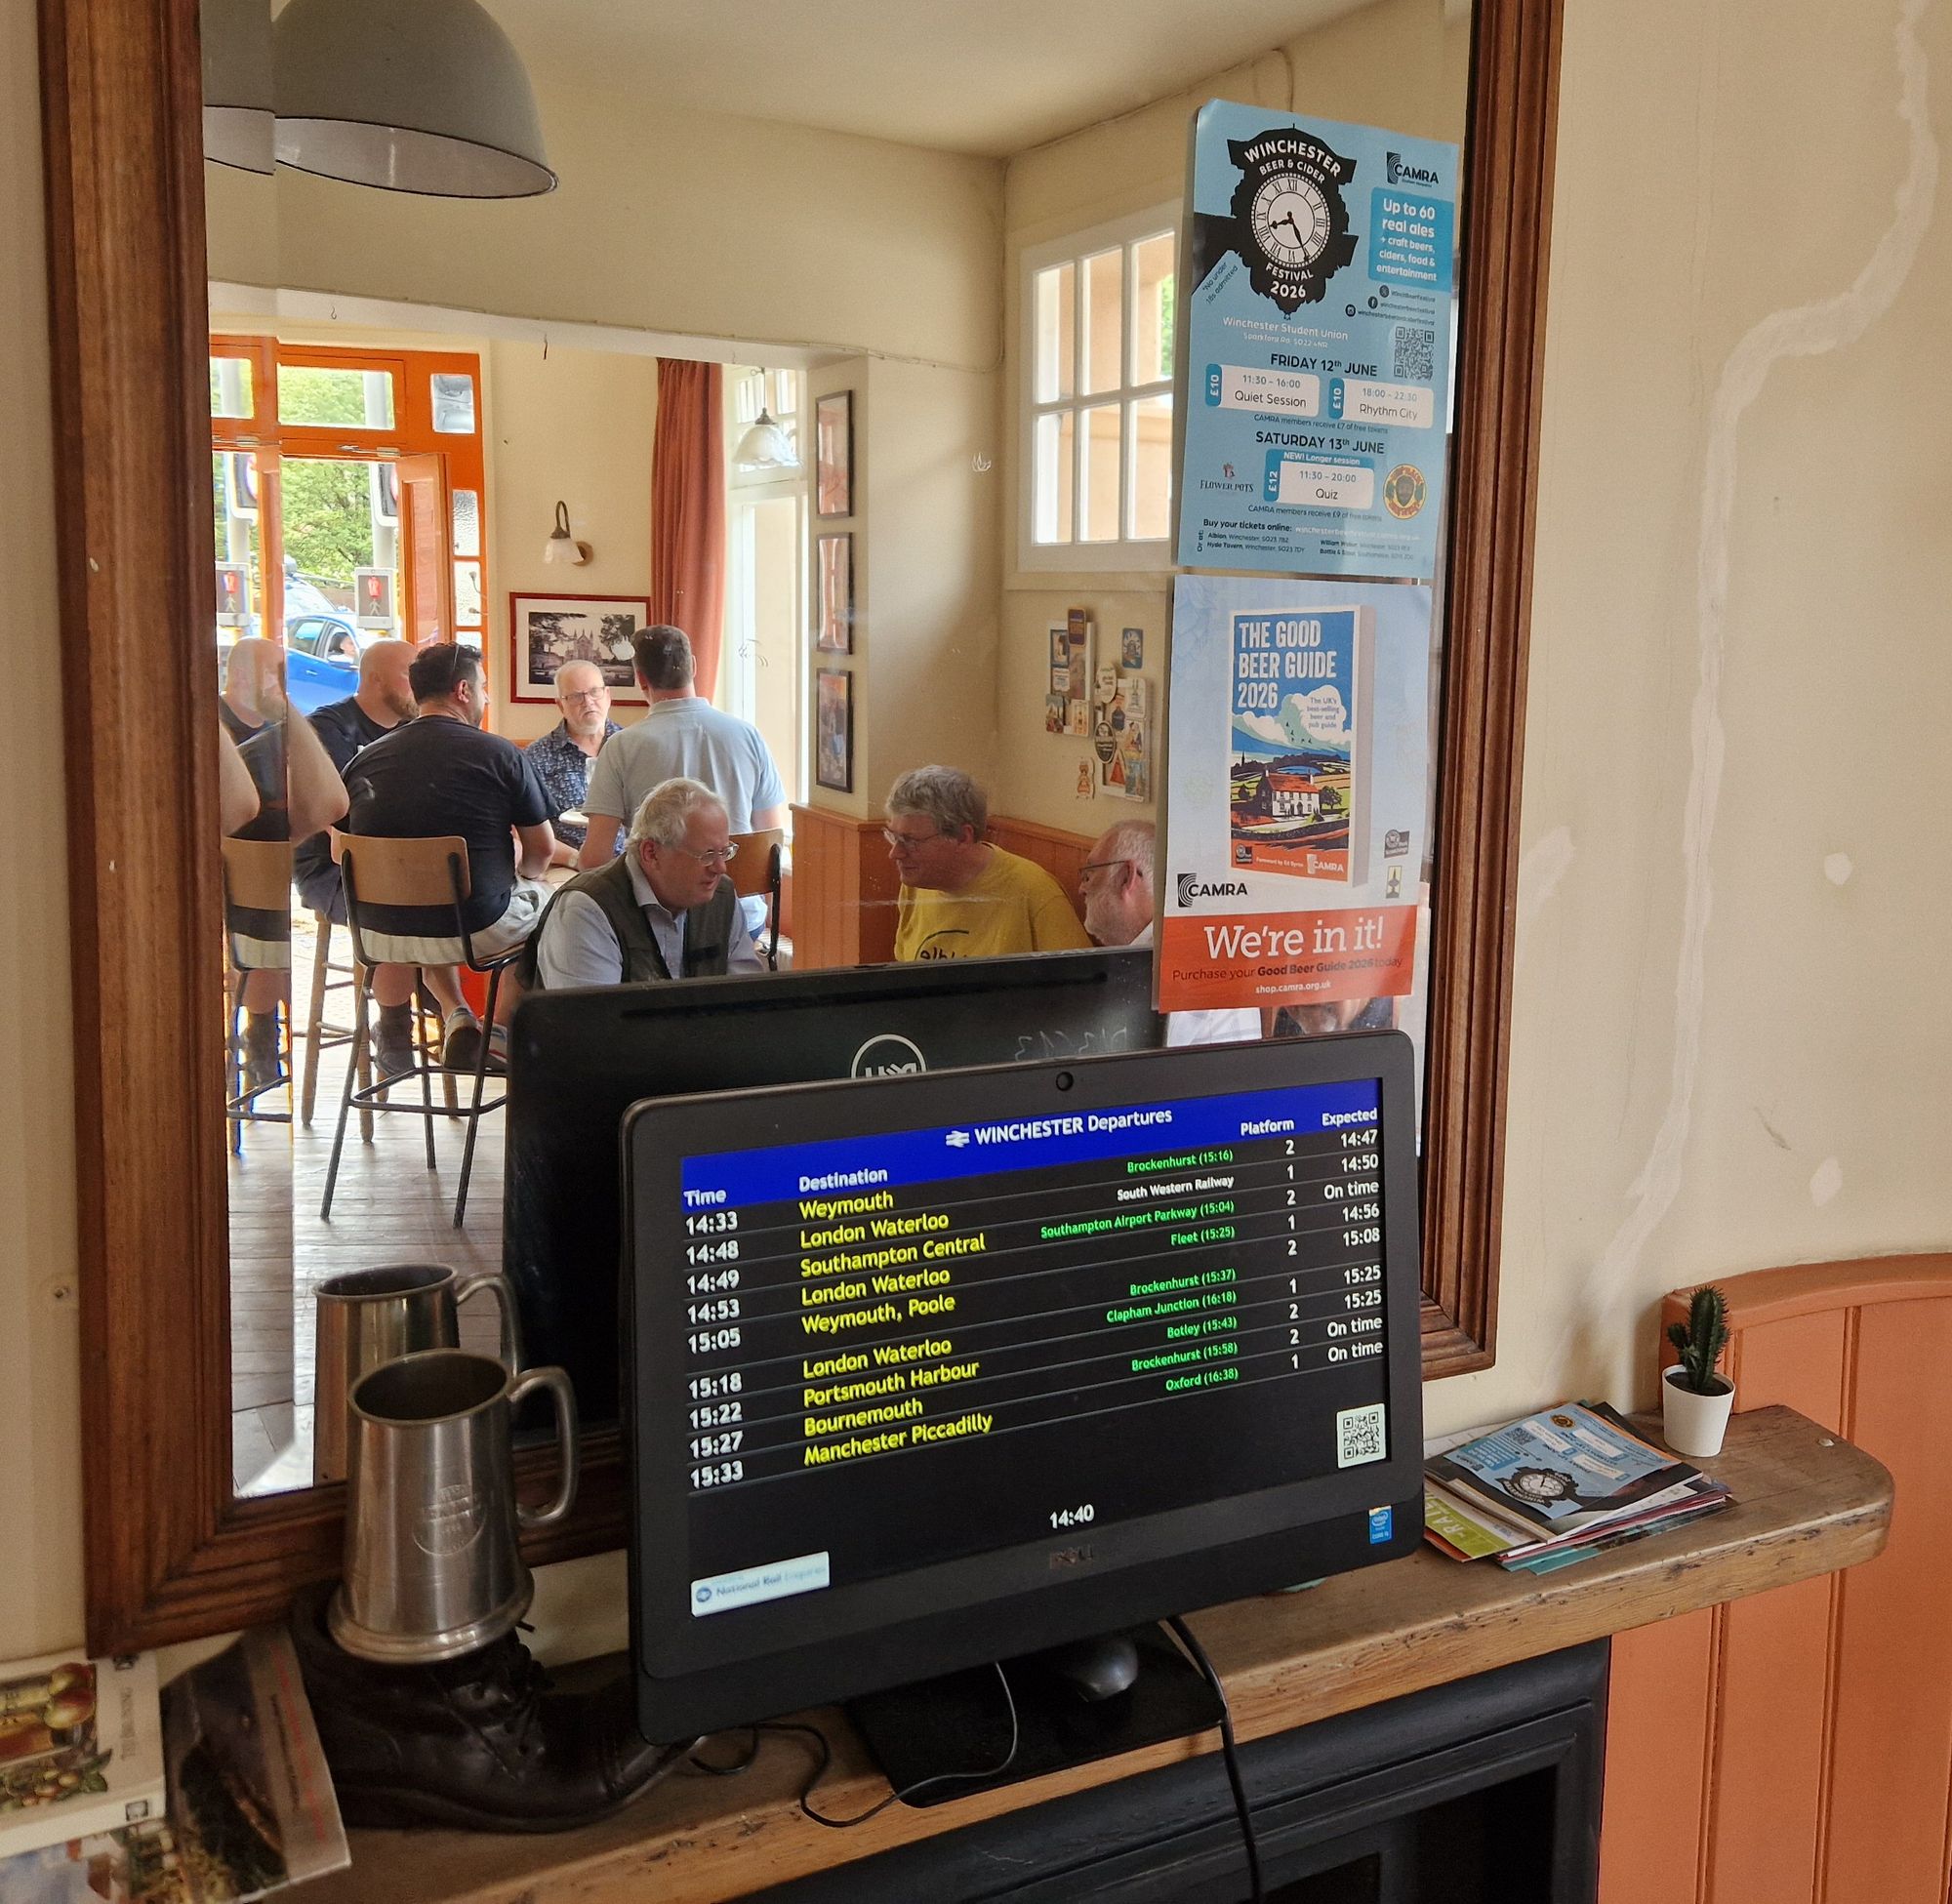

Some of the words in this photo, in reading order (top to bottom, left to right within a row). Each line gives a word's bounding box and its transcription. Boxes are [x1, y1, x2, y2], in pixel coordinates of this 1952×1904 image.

[1244, 140, 1341, 177] WINCHESTER
[1259, 159, 1284, 176] BEER
[1297, 161, 1325, 183] CIDER
[1395, 164, 1439, 183] CAMRA
[1384, 198, 1400, 215] Up
[1403, 204, 1416, 216] to
[1420, 206, 1435, 220] 60
[1382, 219, 1406, 232] real
[1409, 223, 1435, 238] ales
[1388, 237, 1407, 248] craft
[1410, 240, 1435, 253] beers,
[1379, 249, 1406, 263] ciders,
[1408, 254, 1427, 265] food
[1429, 258, 1435, 266] &
[1215, 265, 1238, 294] admitted
[1266, 262, 1314, 281] FESTIVAL
[1376, 263, 1437, 281] entertainment
[1270, 281, 1306, 299] 2026
[1223, 317, 1279, 332] Winchester
[1281, 324, 1318, 337] Student
[1321, 330, 1349, 341] Union
[1271, 353, 1317, 370] FRIDAY
[1345, 363, 1377, 377] JUNE
[1210, 375, 1219, 396] £10
[1242, 375, 1266, 385] 11:30
[1277, 379, 1301, 388] 16:00
[1235, 390, 1263, 403] Quiet
[1267, 394, 1306, 408] Session
[1254, 414, 1280, 423] CAMRA
[1281, 418, 1311, 426] members
[1360, 404, 1397, 417] Rhythm
[1400, 409, 1418, 421] City
[1255, 431, 1325, 448] SATURDAY
[1353, 441, 1384, 454] JUNE
[1284, 452, 1304, 461] NEW!
[1306, 454, 1332, 465] Longer
[1200, 480, 1234, 490] FLOWER
[1235, 483, 1253, 492] POTS
[1269, 471, 1279, 491] £12
[1300, 470, 1322, 480] 11:30
[1331, 472, 1356, 482] 20:00
[1316, 488, 1338, 500] Quiz
[1203, 518, 1218, 527] Buy
[1240, 520, 1265, 530] tickets
[1267, 522, 1292, 532] online:
[1240, 622, 1271, 648] THE
[1276, 620, 1322, 648] GOOD
[1239, 652, 1281, 678] BEER
[1285, 651, 1337, 678] GUIDE
[1238, 682, 1278, 709] 2026
[1313, 860, 1344, 872] CAMRA
[1188, 883, 1247, 897] CAMRA
[1204, 925, 1304, 958] We're
[1313, 919, 1346, 953] in
[1354, 915, 1384, 951] it!
[1173, 968, 1227, 981] Purchase
[1227, 968, 1256, 980] your
[1258, 965, 1287, 976] Good
[1289, 964, 1315, 974] Beer
[1317, 961, 1346, 972] Guide
[1348, 958, 1373, 970] 2026
[1374, 956, 1403, 968] today
[1255, 980, 1331, 993] shop.camra.org.uk
[975, 1116, 1083, 1145] WINCHESTER
[1088, 1110, 1172, 1132] Departures
[684, 1189, 726, 1206] Time
[799, 1167, 888, 1193] Destination
[1240, 1119, 1294, 1136] Platform
[1322, 1108, 1377, 1127] Expected
[686, 1211, 738, 1236] 14:33
[799, 1191, 893, 1220] Weymouth
[1127, 1155, 1196, 1173] Brockenhurst
[1199, 1150, 1233, 1165] (15:16)
[1340, 1129, 1377, 1148] 14:47
[686, 1240, 739, 1265] 14:48
[800, 1224, 865, 1249] London
[871, 1213, 949, 1237] Waterloo
[1118, 1187, 1148, 1201] South
[1150, 1181, 1193, 1196] Western
[1196, 1175, 1234, 1191] Railway
[1341, 1154, 1378, 1172] 14:50
[687, 1270, 739, 1294] 14:49
[800, 1245, 917, 1277] Southampton
[923, 1233, 986, 1259] Central
[1040, 1218, 1113, 1239] Southampton
[1114, 1211, 1152, 1229] Airport
[1155, 1204, 1198, 1222] Parkway
[1200, 1201, 1235, 1217] (15:04)
[1324, 1184, 1343, 1199] On
[1348, 1181, 1379, 1195] time
[688, 1299, 740, 1324] 14:53
[802, 1280, 867, 1306] London
[873, 1269, 951, 1295] Waterloo
[1171, 1232, 1198, 1246] Fleet
[1200, 1226, 1235, 1242] (15:25)
[1343, 1203, 1380, 1222] 14:56
[688, 1327, 741, 1354] 15:05
[802, 1303, 902, 1334] Weymouth,
[909, 1294, 956, 1317] Poole
[1343, 1228, 1380, 1247] 15:08
[1130, 1275, 1199, 1296] Brockenhurst
[1201, 1268, 1236, 1286] (15:37)
[688, 1373, 742, 1399] 15:18
[803, 1353, 868, 1379] London
[874, 1339, 952, 1366] Waterloo
[1106, 1306, 1152, 1322] Clapham
[1155, 1298, 1200, 1315] Junction
[1202, 1291, 1237, 1308] (16:18)
[1344, 1265, 1381, 1284] 15:25
[690, 1402, 743, 1429] 15:22
[804, 1374, 905, 1407] Portsmouth
[911, 1360, 980, 1388] Harbour
[1167, 1323, 1200, 1339] Botley
[1202, 1317, 1238, 1333] (15:43)
[1345, 1289, 1382, 1310] 15:25
[690, 1432, 743, 1459] 15:27
[804, 1398, 923, 1437] Bournemouth
[1131, 1351, 1201, 1371] Brockenhurst
[1203, 1342, 1238, 1359] (15:58)
[690, 1461, 744, 1488] 15:33
[804, 1430, 907, 1466] Manchester
[912, 1413, 993, 1443] Piccadilly
[1165, 1374, 1201, 1391] Oxford
[1204, 1368, 1239, 1386] (16:38)
[1049, 1504, 1094, 1528] 14:40
[716, 1577, 759, 1596] National
[763, 1575, 781, 1585] Rail
